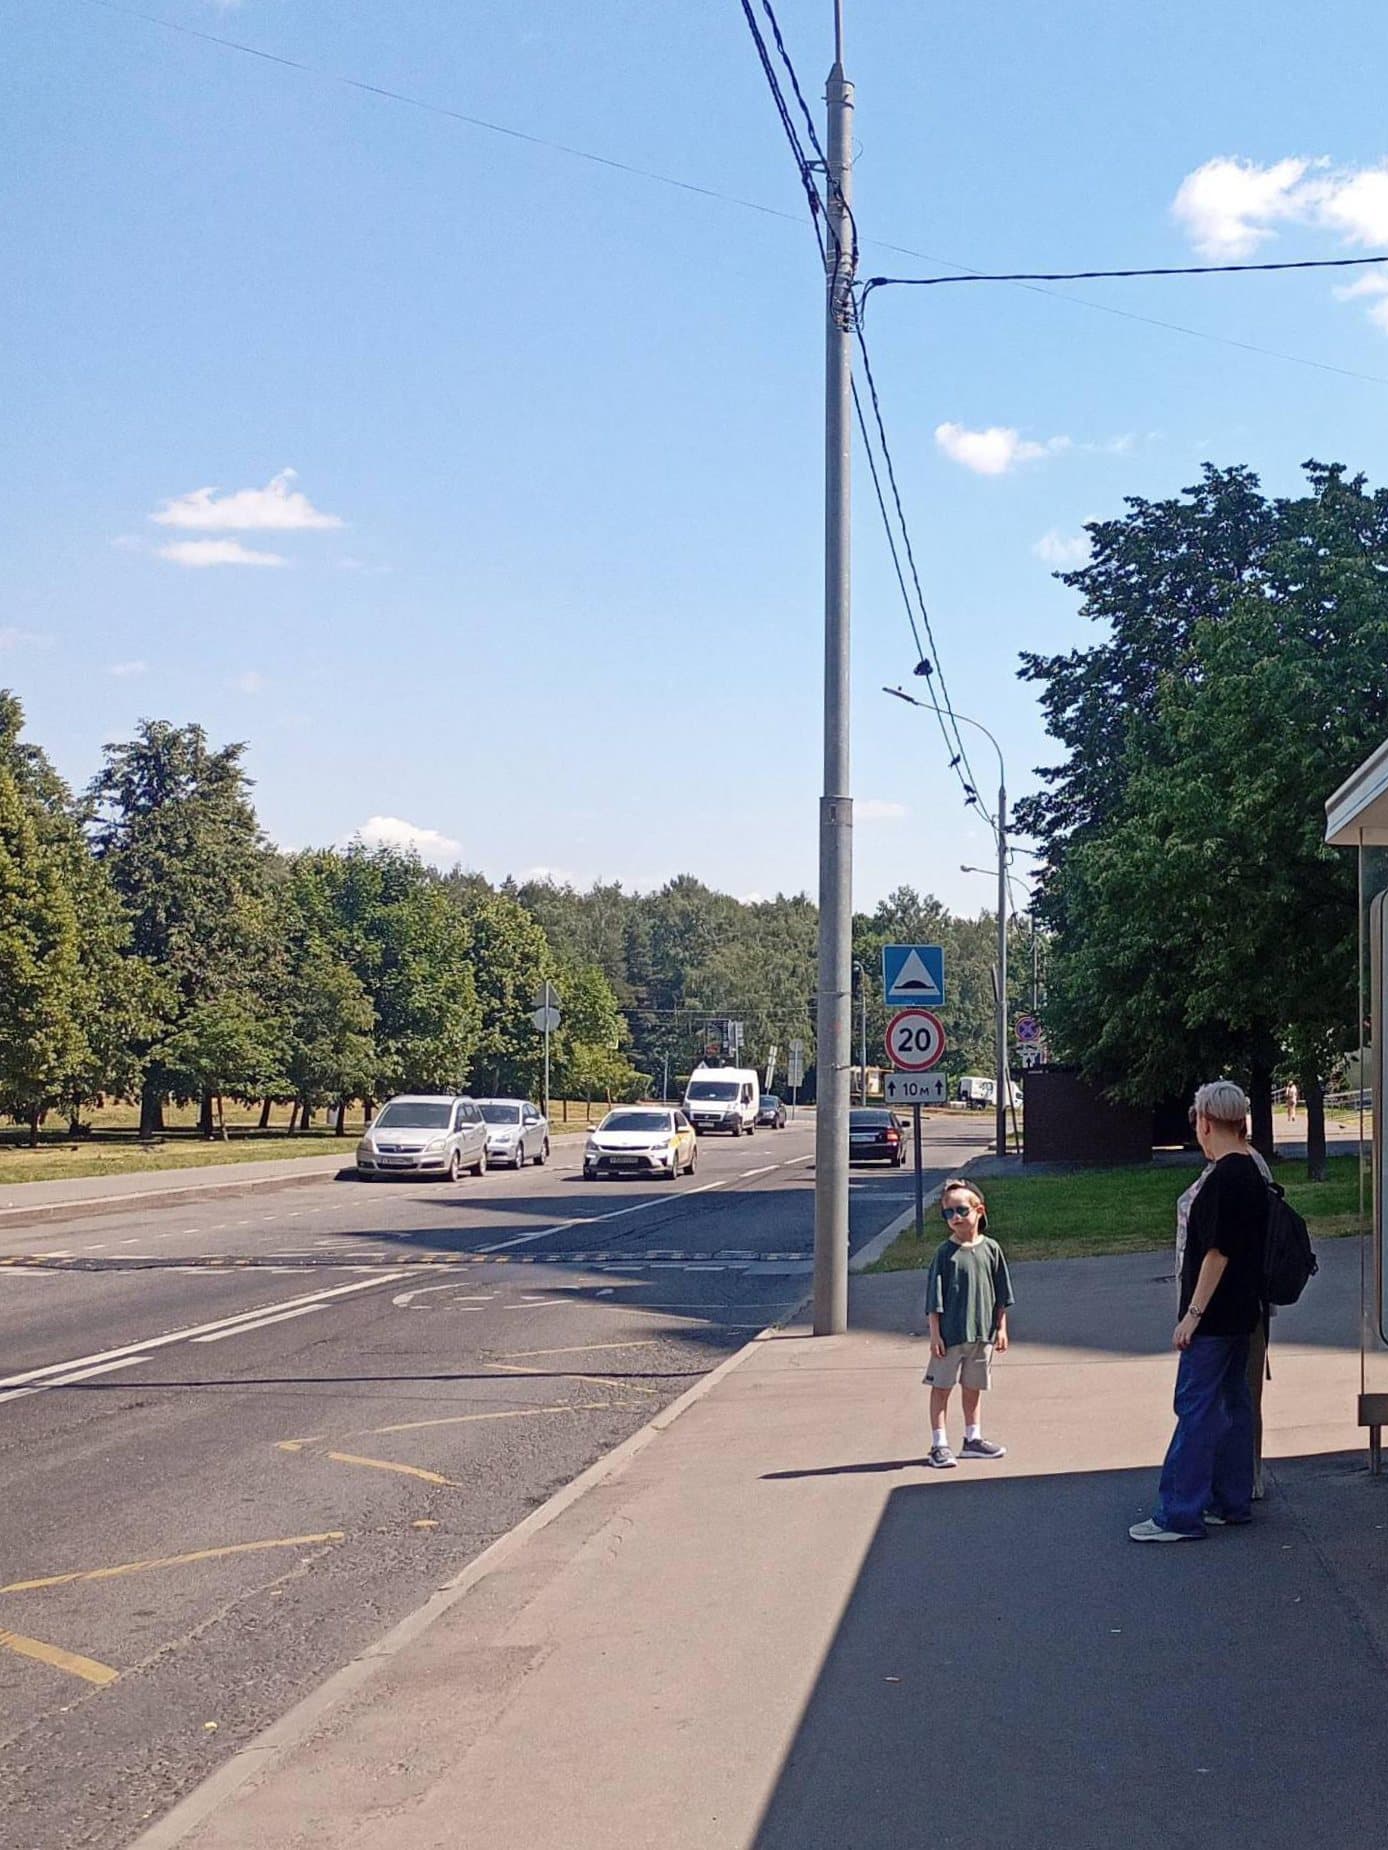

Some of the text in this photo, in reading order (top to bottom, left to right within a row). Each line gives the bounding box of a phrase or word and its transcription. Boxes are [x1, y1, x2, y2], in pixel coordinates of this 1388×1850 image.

[898, 1027, 931, 1052] 20
[902, 1083, 930, 1096] 10 м
